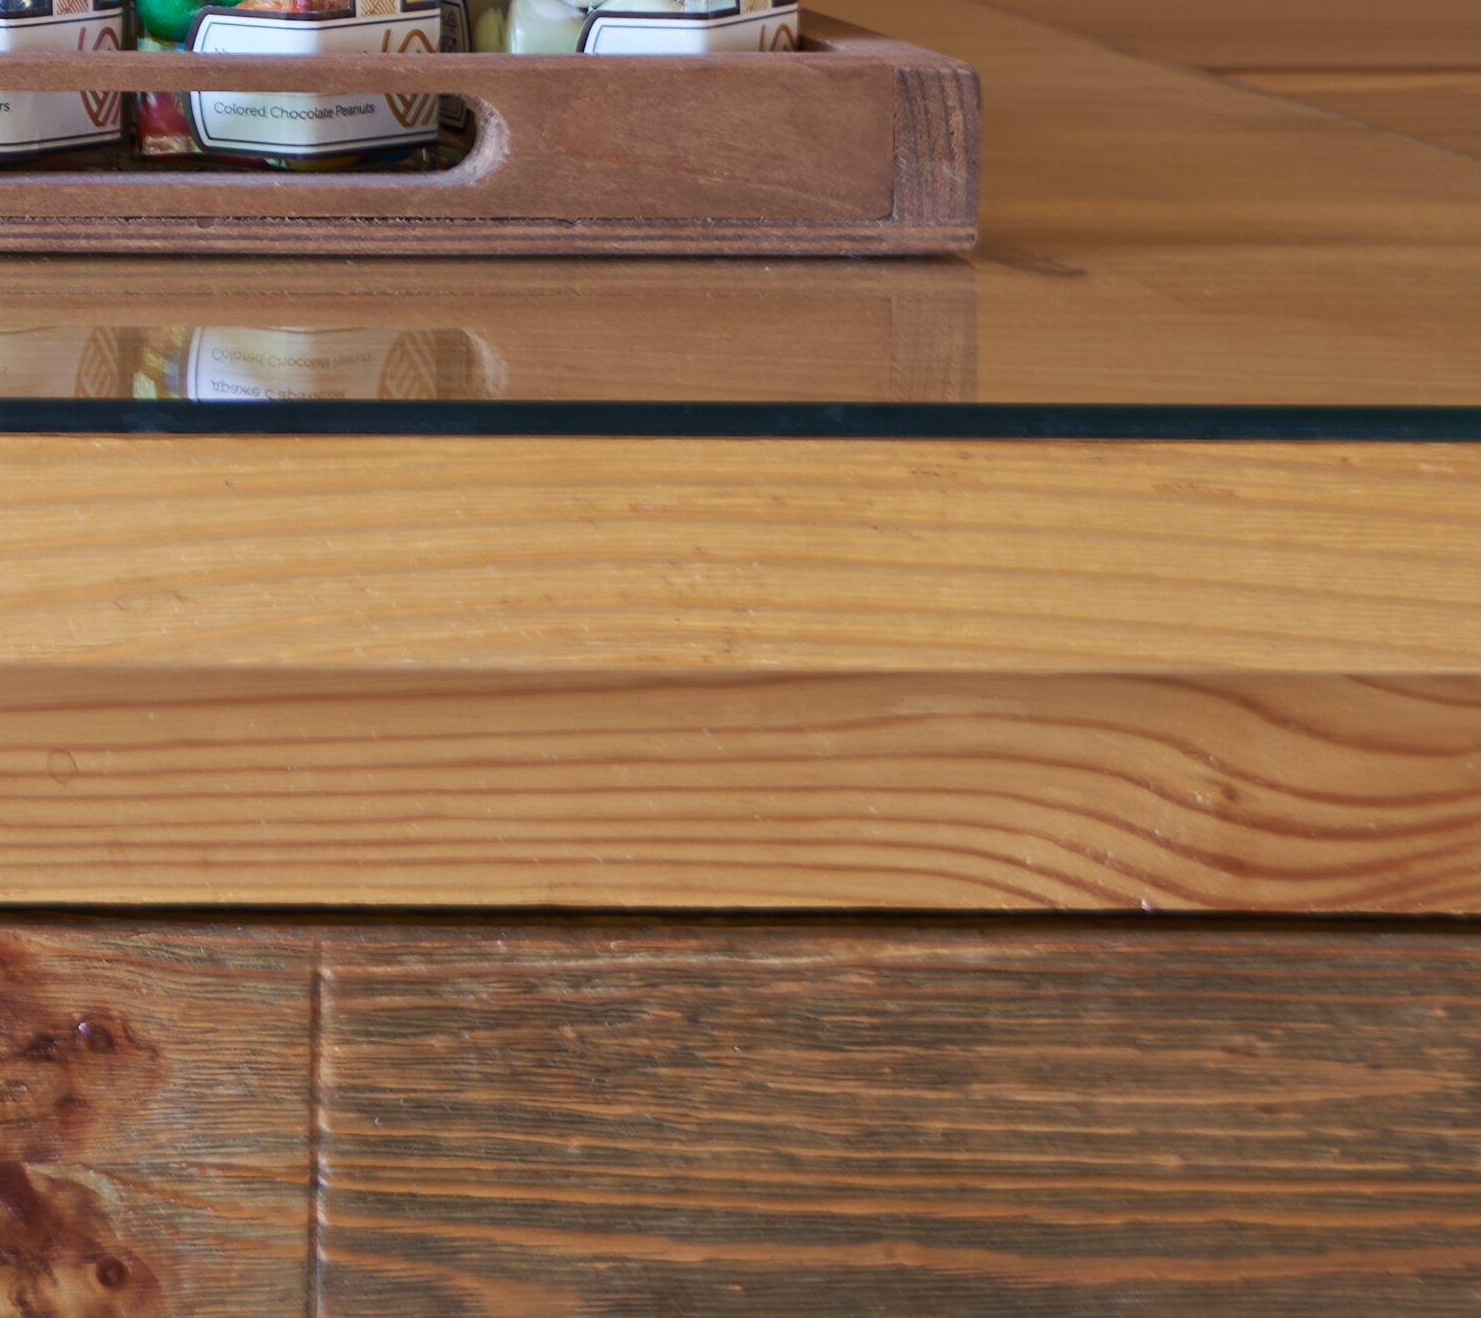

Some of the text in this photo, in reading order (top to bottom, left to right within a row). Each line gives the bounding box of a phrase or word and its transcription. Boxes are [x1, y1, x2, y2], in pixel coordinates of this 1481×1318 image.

[213, 101, 375, 120] Colored Chocolate Peanuts
